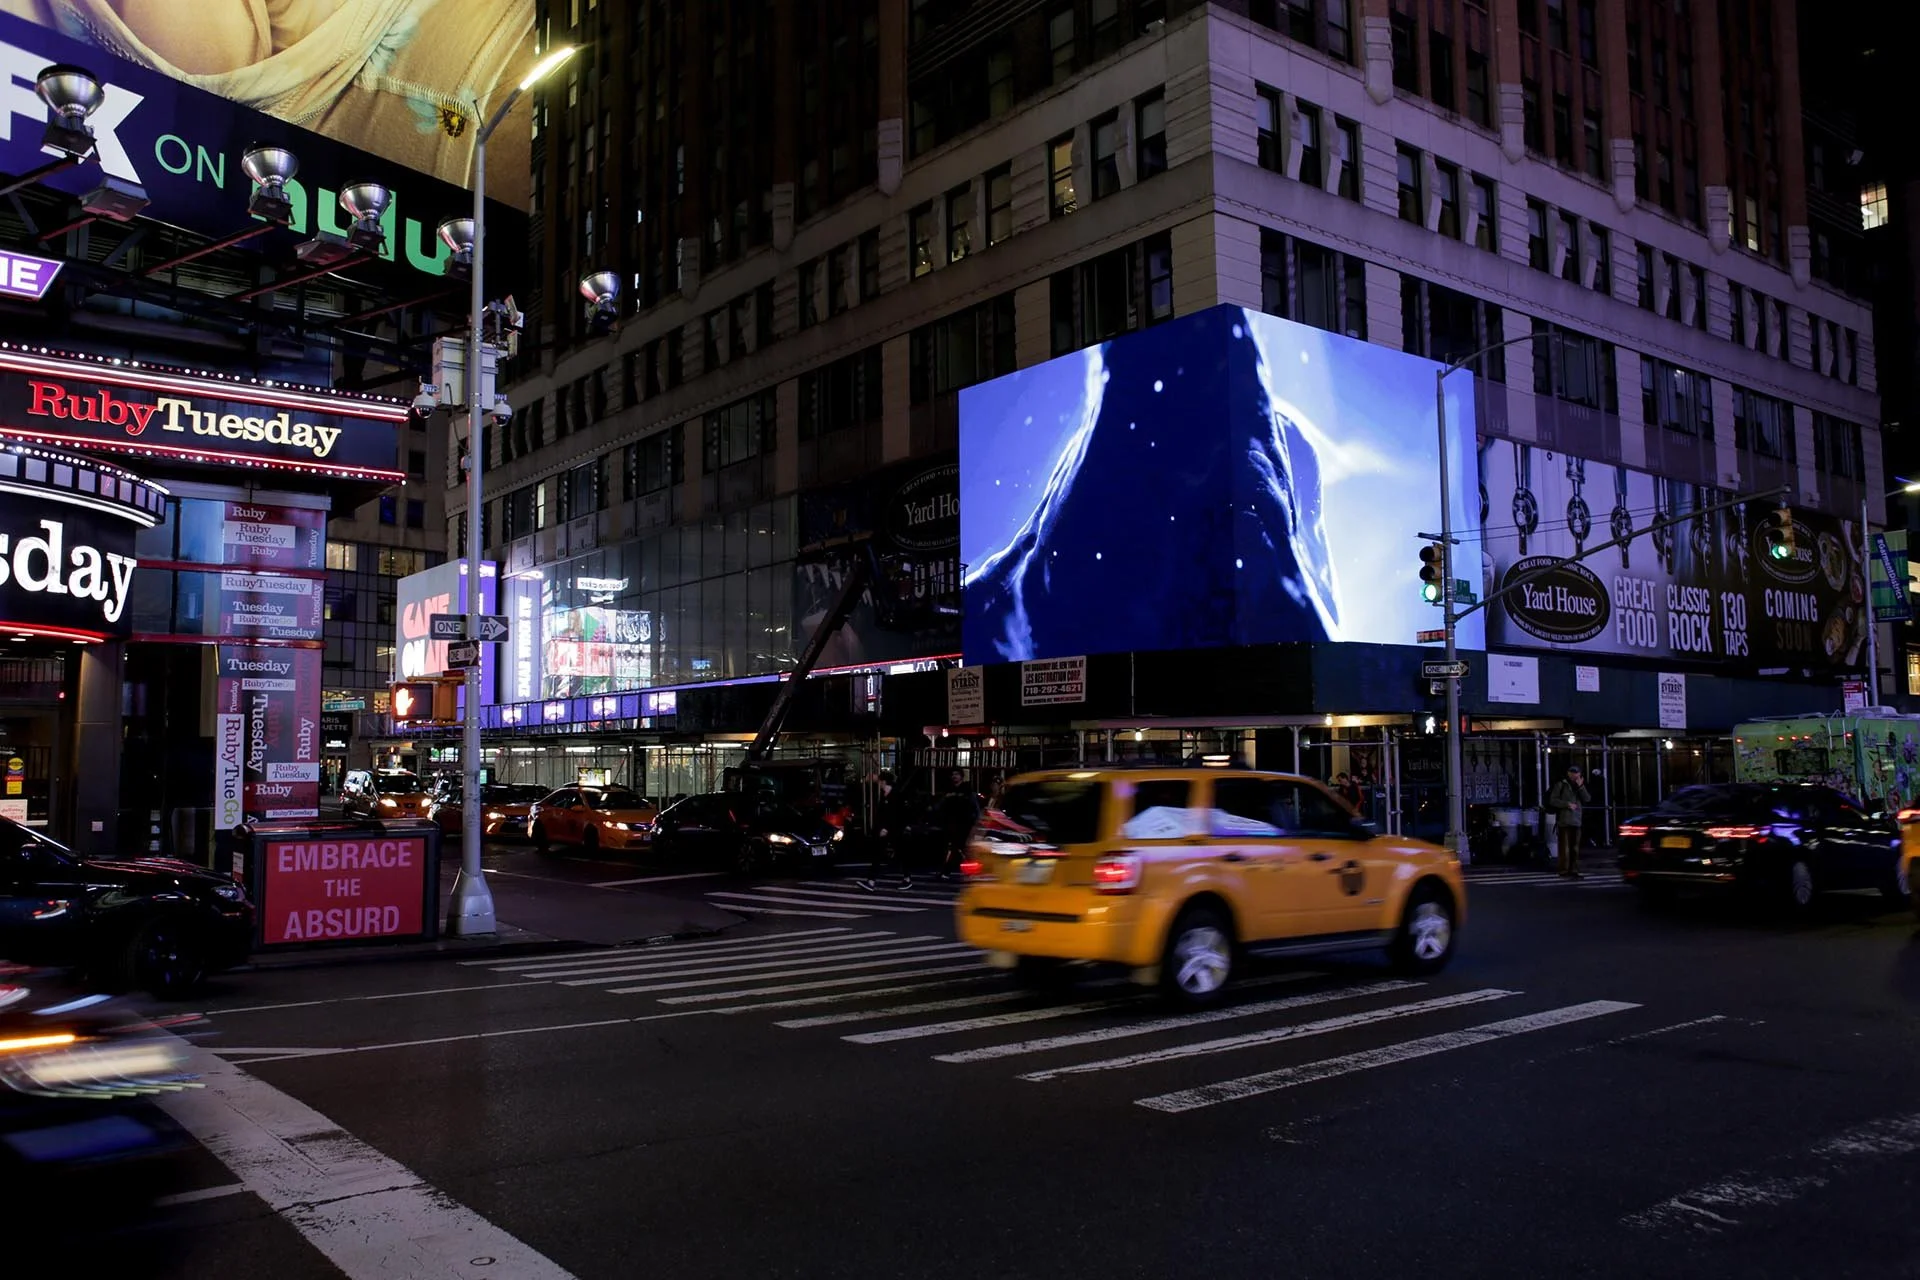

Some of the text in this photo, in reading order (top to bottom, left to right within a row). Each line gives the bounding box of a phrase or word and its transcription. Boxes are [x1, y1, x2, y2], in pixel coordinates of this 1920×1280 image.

[154, 134, 225, 189] ON
[232, 506, 266, 520] Ruby
[904, 497, 937, 527] Yard
[236, 532, 286, 545] Tuesday
[240, 523, 271, 535] Ruby
[251, 546, 279, 557] Ruby
[308, 528, 320, 568] Tuesday
[232, 600, 285, 613] Tuesday
[312, 583, 322, 626] Tuesday
[1522, 583, 1597, 616] Yard House
[1614, 575, 1656, 611] GREAT
[1667, 583, 1710, 614] CLASSIC
[1765, 588, 1818, 623] COMING
[1720, 591, 1746, 631] 130
[270, 627, 316, 639] Tuesday
[437, 622, 460, 633] ONE
[1615, 608, 1658, 648] FOOD
[1669, 611, 1713, 653] ROCK
[1776, 621, 1812, 652] SOON
[1723, 630, 1749, 657] TAPS
[227, 658, 291, 675] Tuesday
[230, 680, 240, 713] Tuesday
[246, 693, 269, 774] Tuesday
[297, 717, 315, 760] Ruby
[272, 771, 311, 780] Tuesday
[275, 764, 300, 772] Ruby
[255, 784, 293, 798] Ruby
[279, 842, 412, 872] EMBRACE
[324, 878, 361, 897] THE
[283, 905, 401, 939] ABSURD
